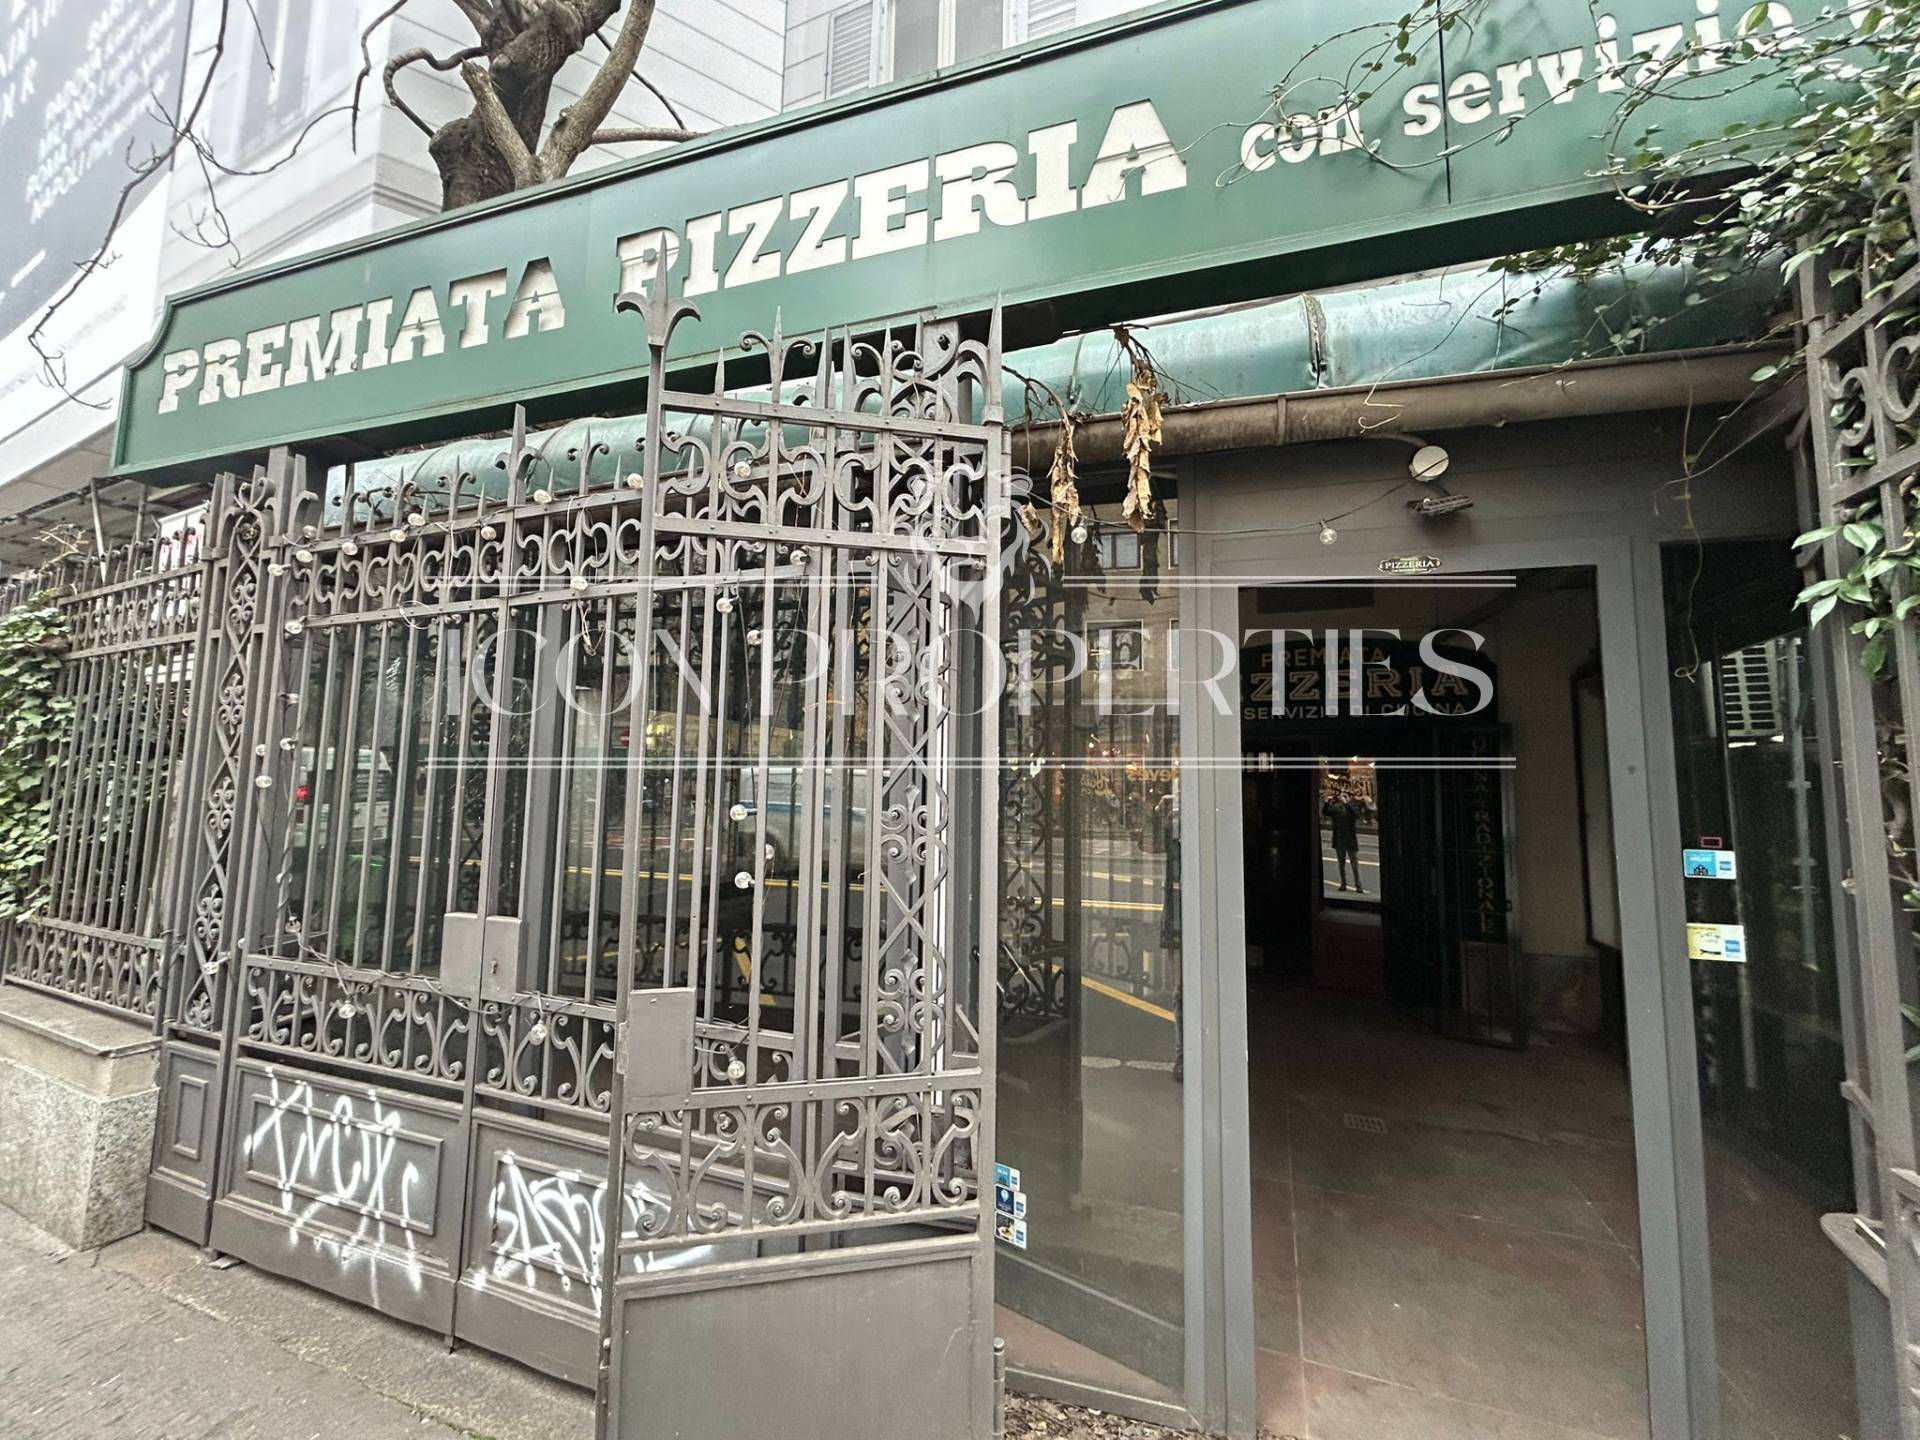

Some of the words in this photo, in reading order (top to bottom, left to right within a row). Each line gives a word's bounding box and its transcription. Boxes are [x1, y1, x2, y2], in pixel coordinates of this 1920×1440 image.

[158, 256, 566, 415] PREMIATA
[614, 98, 1188, 307] PIZZERIA
[1241, 101, 1365, 172] con
[1402, 0, 1795, 137] servizio
[1385, 560, 1435, 569] PIZZERIA
[1261, 647, 1384, 668] PREMIATA
